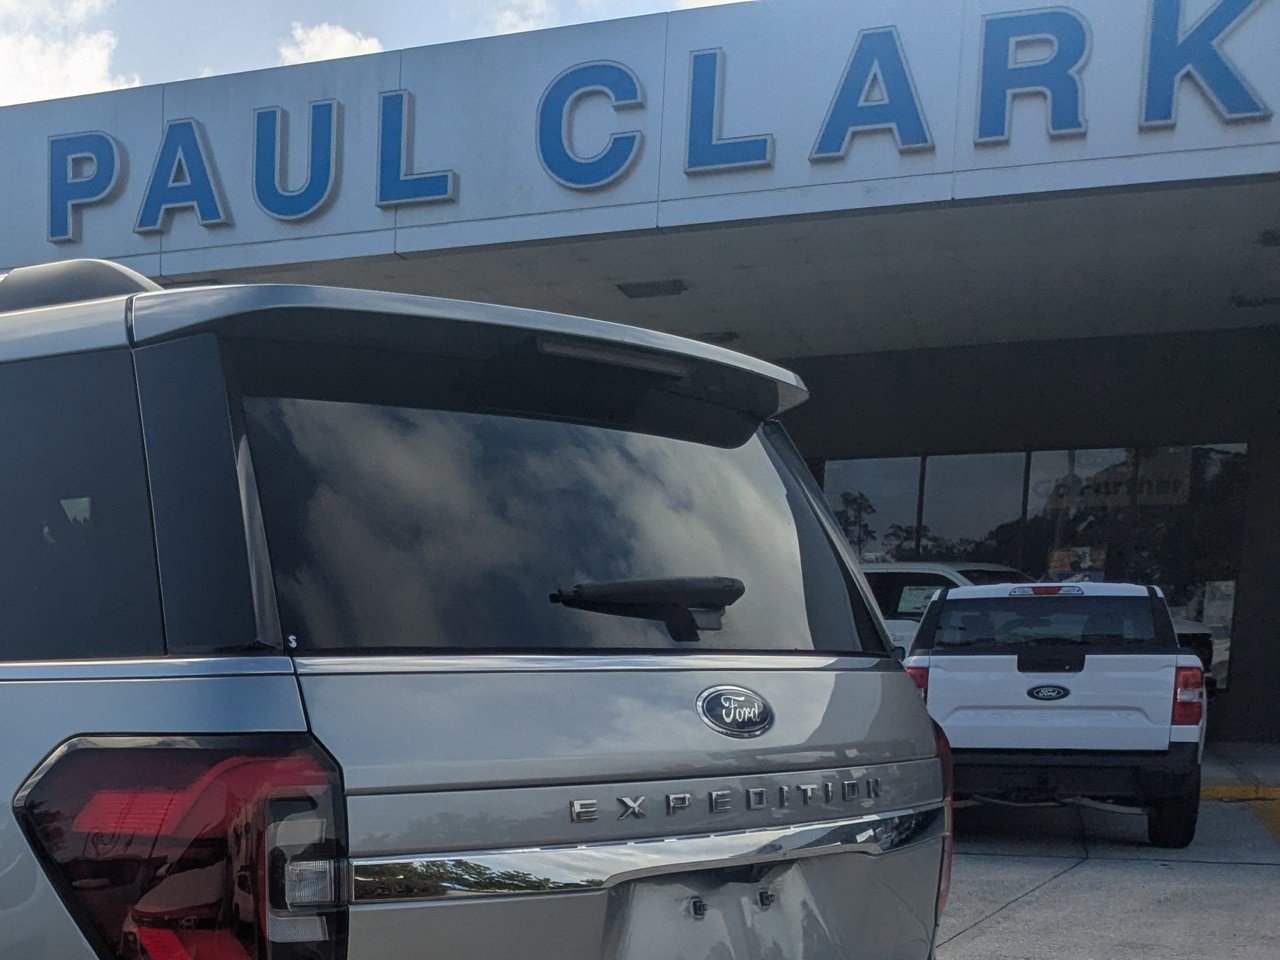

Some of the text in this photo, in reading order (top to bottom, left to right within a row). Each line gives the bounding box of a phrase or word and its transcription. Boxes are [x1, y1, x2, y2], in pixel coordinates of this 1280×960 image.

[47, 0, 1273, 244] PAUL CLARK
[721, 695, 761, 723] Ford
[570, 777, 884, 823] EXPEDITION
